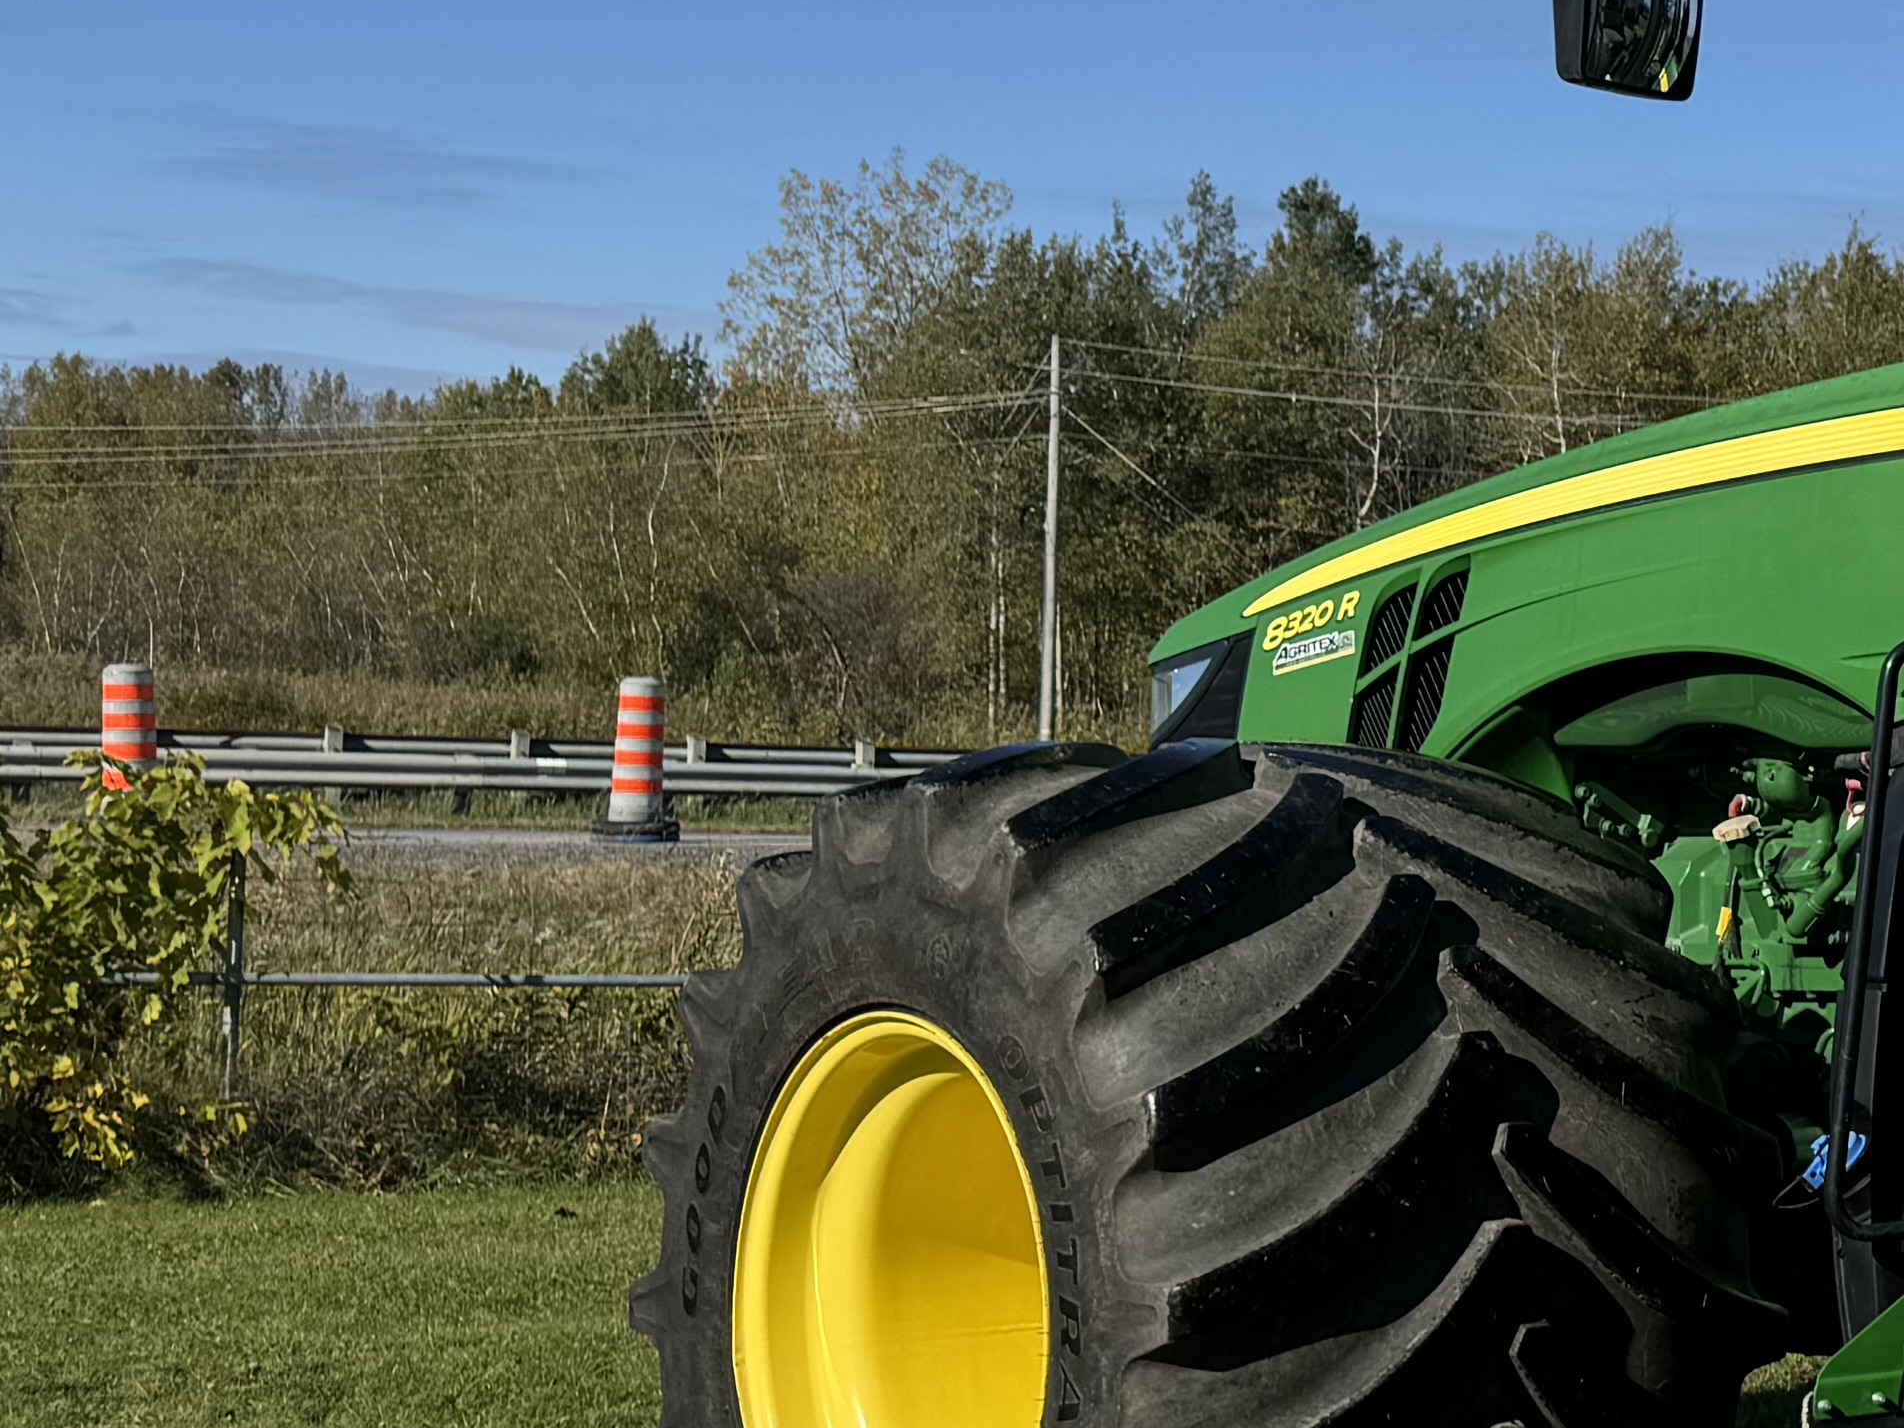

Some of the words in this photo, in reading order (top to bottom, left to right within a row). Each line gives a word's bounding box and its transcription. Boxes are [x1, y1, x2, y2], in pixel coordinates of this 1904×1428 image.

[1262, 599, 1334, 651] 8320
[1336, 590, 1361, 621] R
[1276, 633, 1337, 661] AGRITEX
